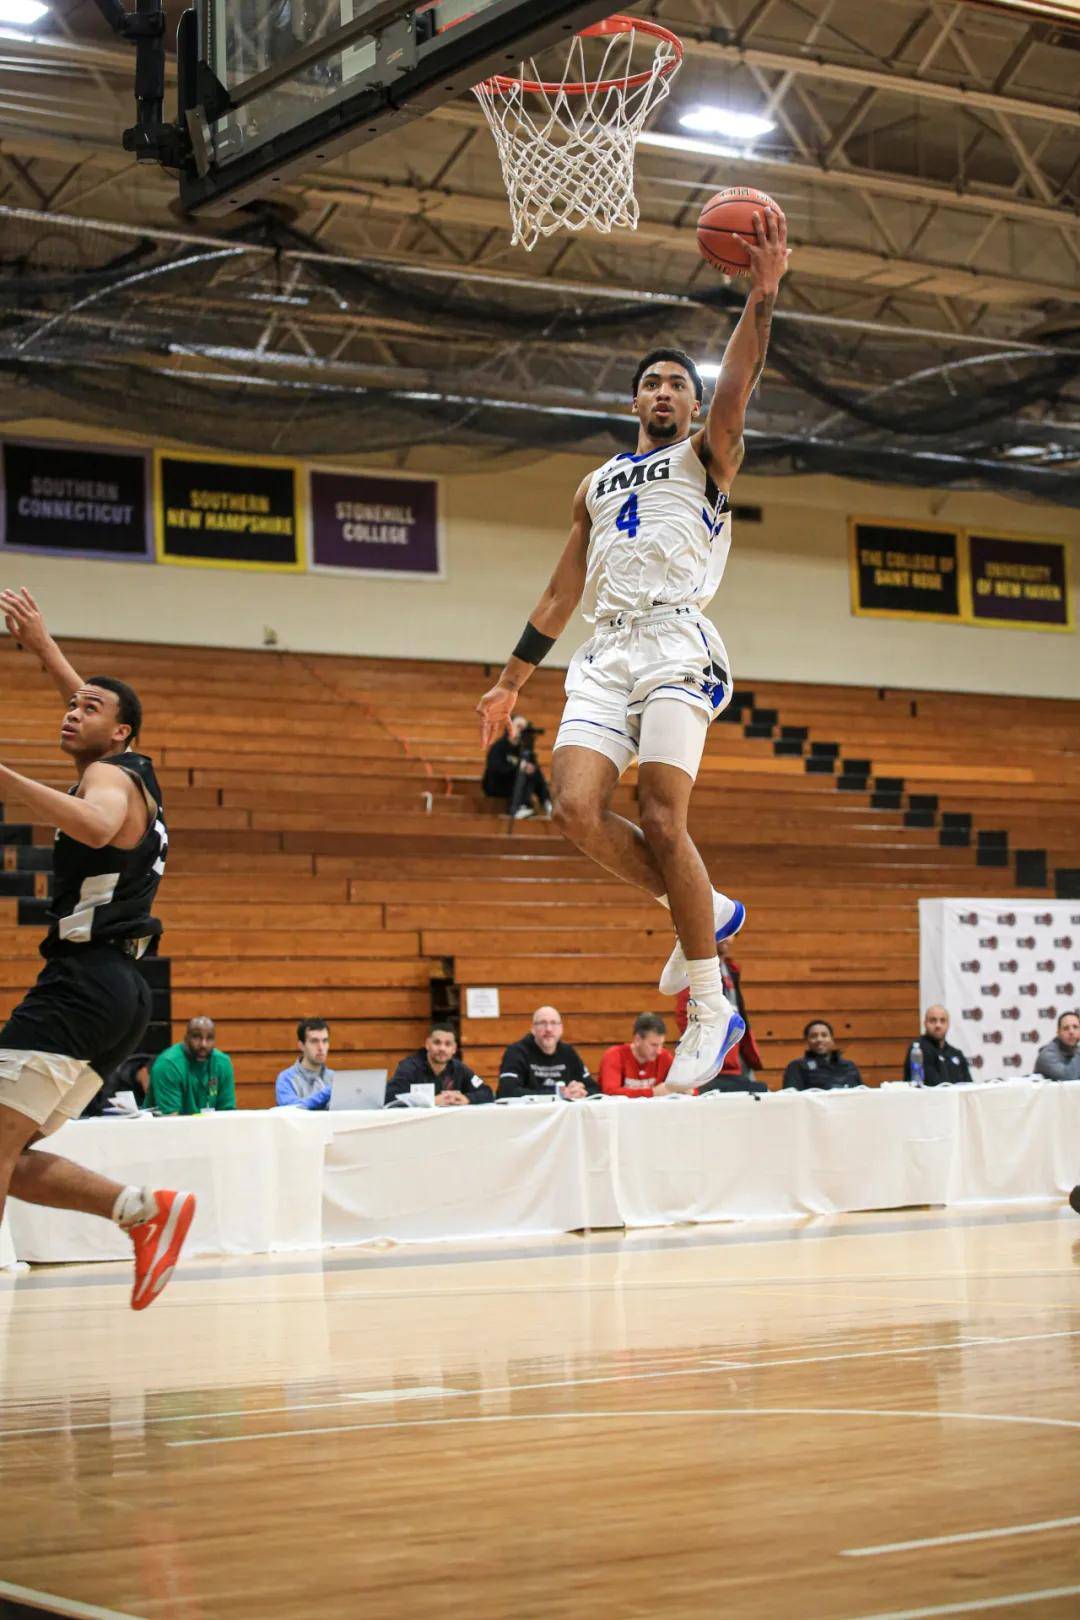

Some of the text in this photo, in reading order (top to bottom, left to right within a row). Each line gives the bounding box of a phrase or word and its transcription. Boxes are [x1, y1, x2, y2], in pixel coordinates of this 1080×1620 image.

[595, 457, 671, 500] IMG
[18, 496, 135, 525] CONNECTICUT
[190, 490, 270, 513] SOUTHERN
[335, 501, 416, 525] STONEHILL
[615, 492, 641, 538] 4
[166, 508, 293, 536] NEW HAMPSHIRE
[342, 521, 408, 545] COLLEGE
